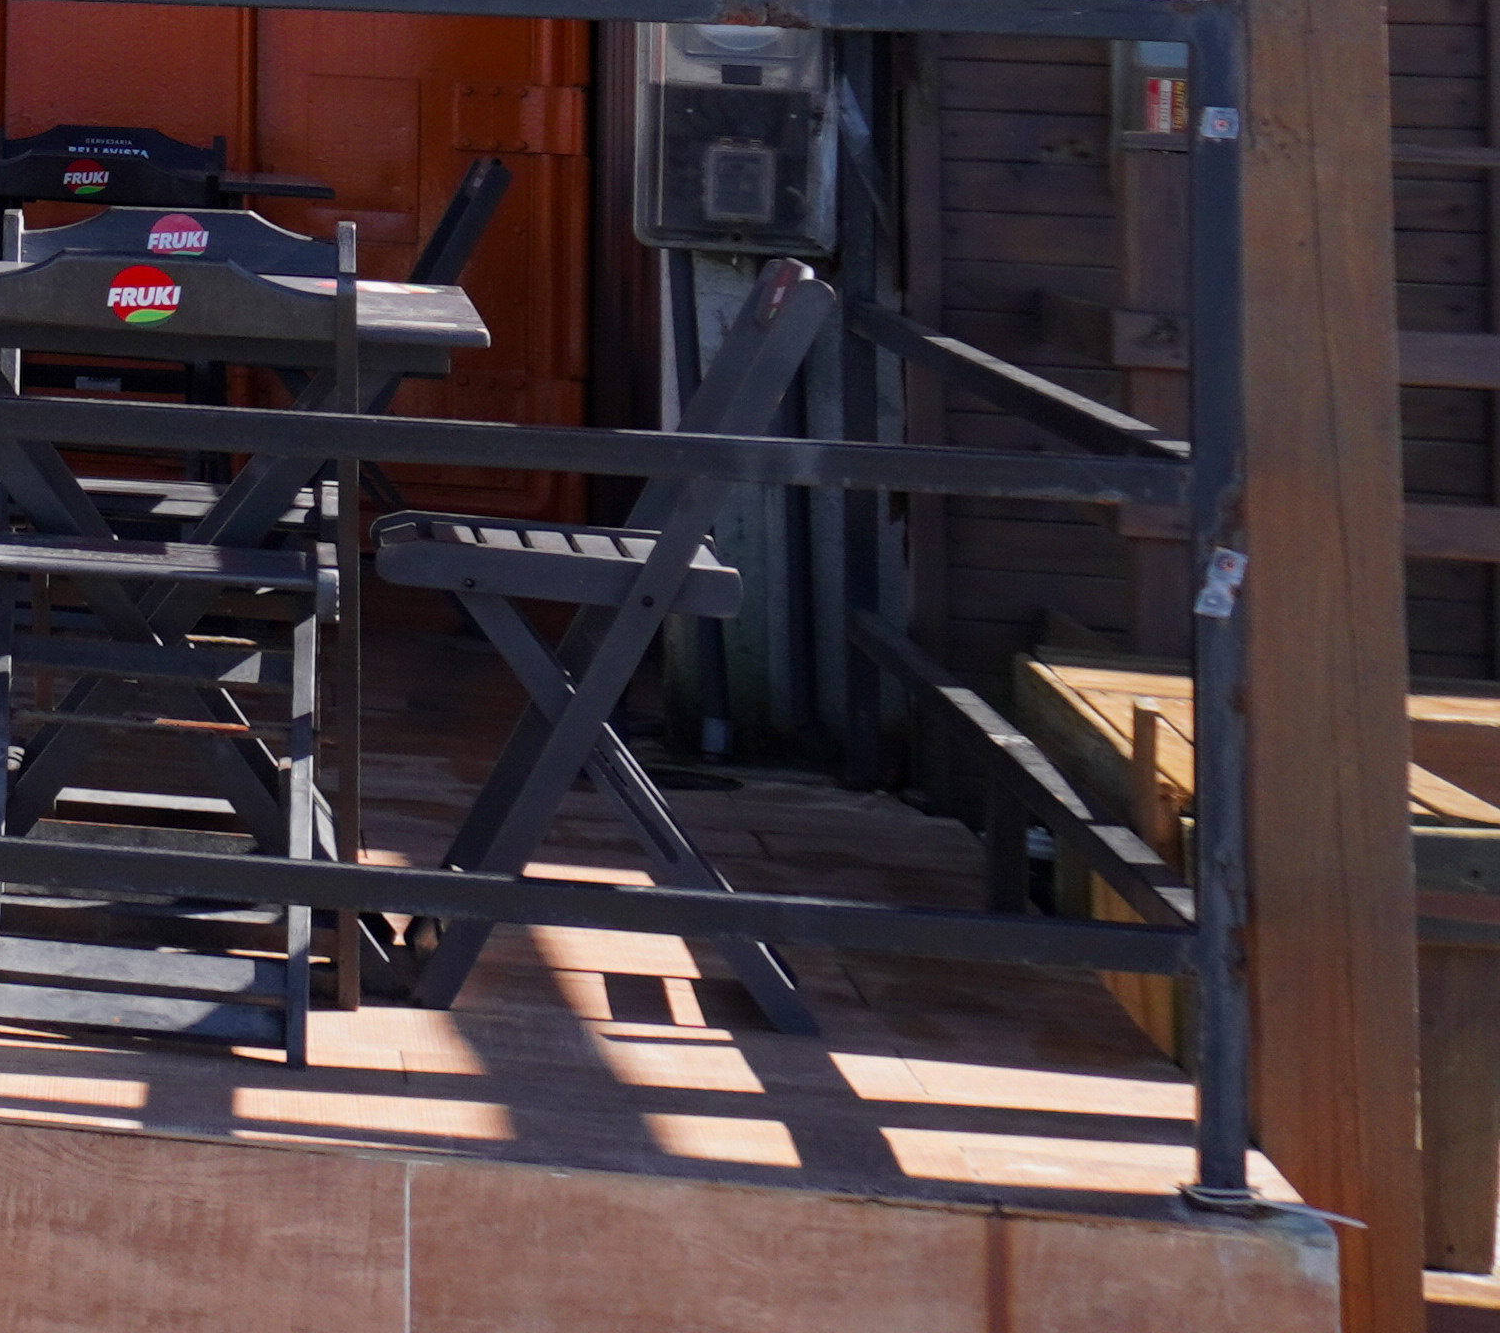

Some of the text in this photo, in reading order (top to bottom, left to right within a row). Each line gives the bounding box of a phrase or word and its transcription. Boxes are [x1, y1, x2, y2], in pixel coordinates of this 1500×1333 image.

[63, 171, 110, 185] FRUKI
[147, 231, 209, 250] FRUKI
[107, 286, 182, 307] FRUKI
